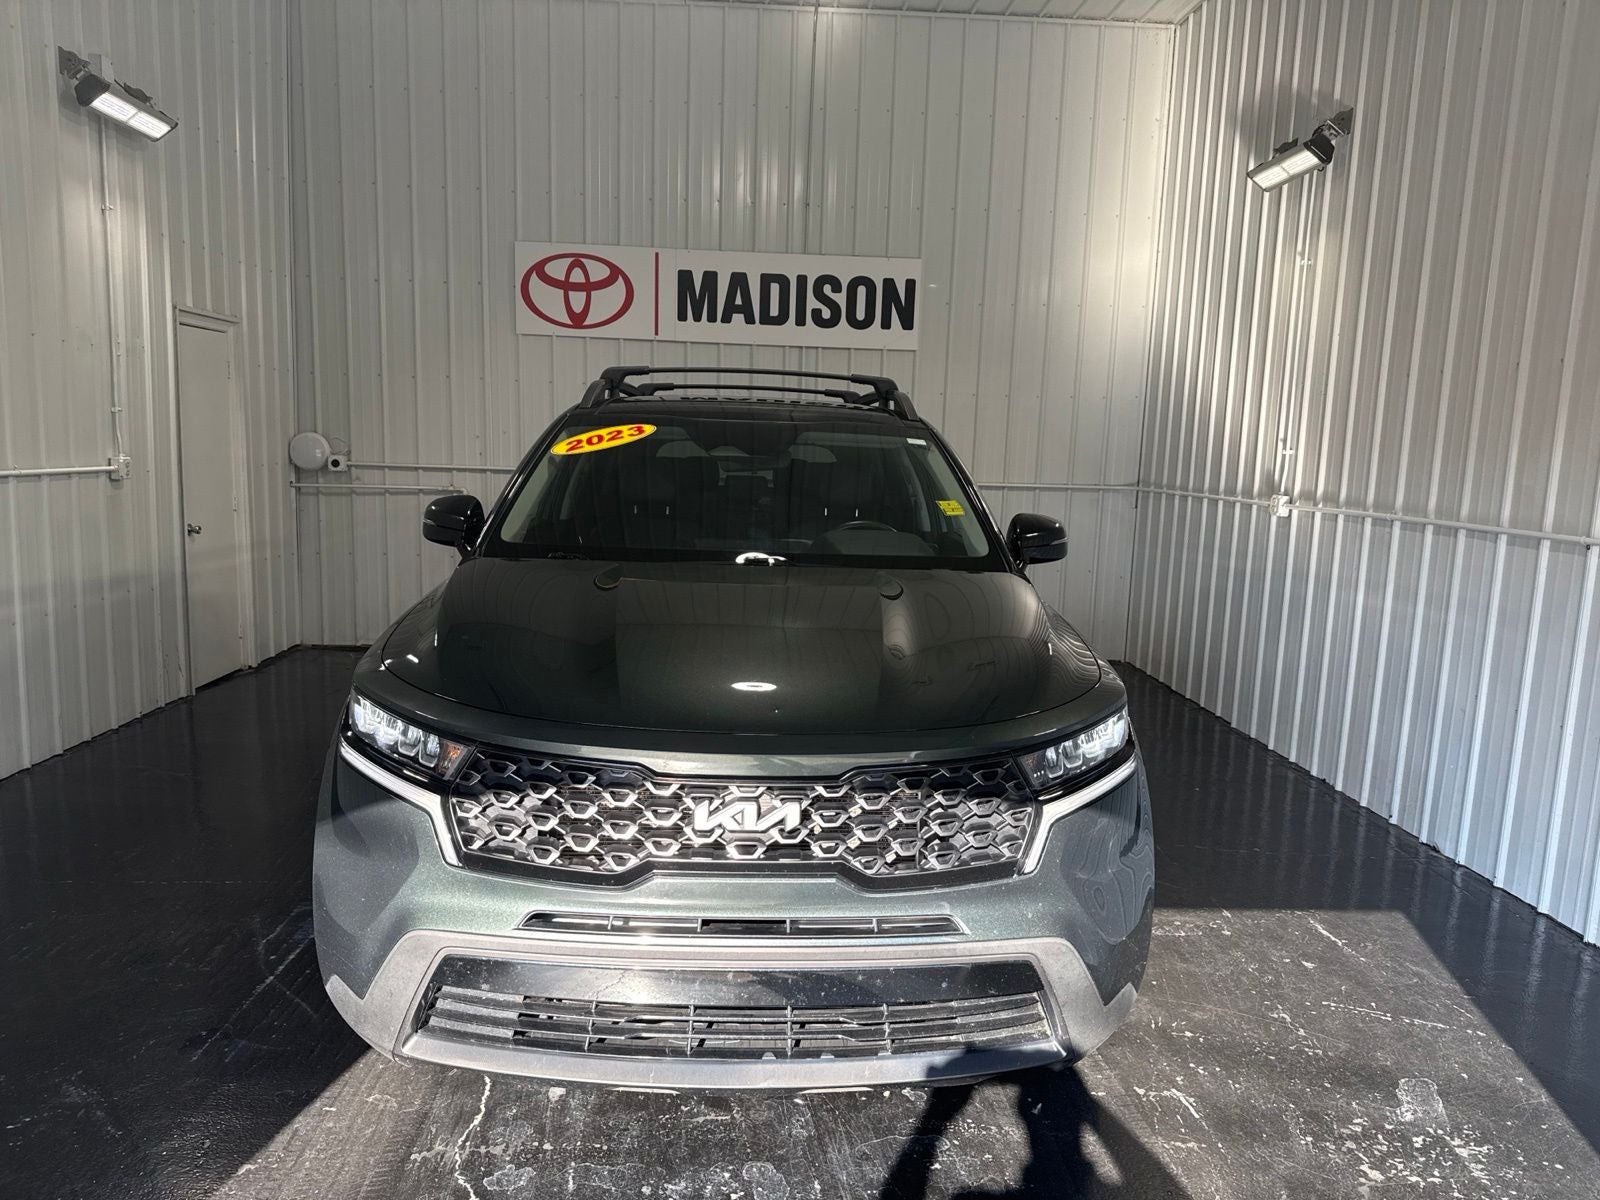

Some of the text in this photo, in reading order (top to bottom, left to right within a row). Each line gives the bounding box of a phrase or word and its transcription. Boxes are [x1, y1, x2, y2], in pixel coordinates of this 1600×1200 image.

[677, 269, 916, 331] MADISON
[566, 425, 645, 452] 2023
[694, 800, 801, 832] KIA
